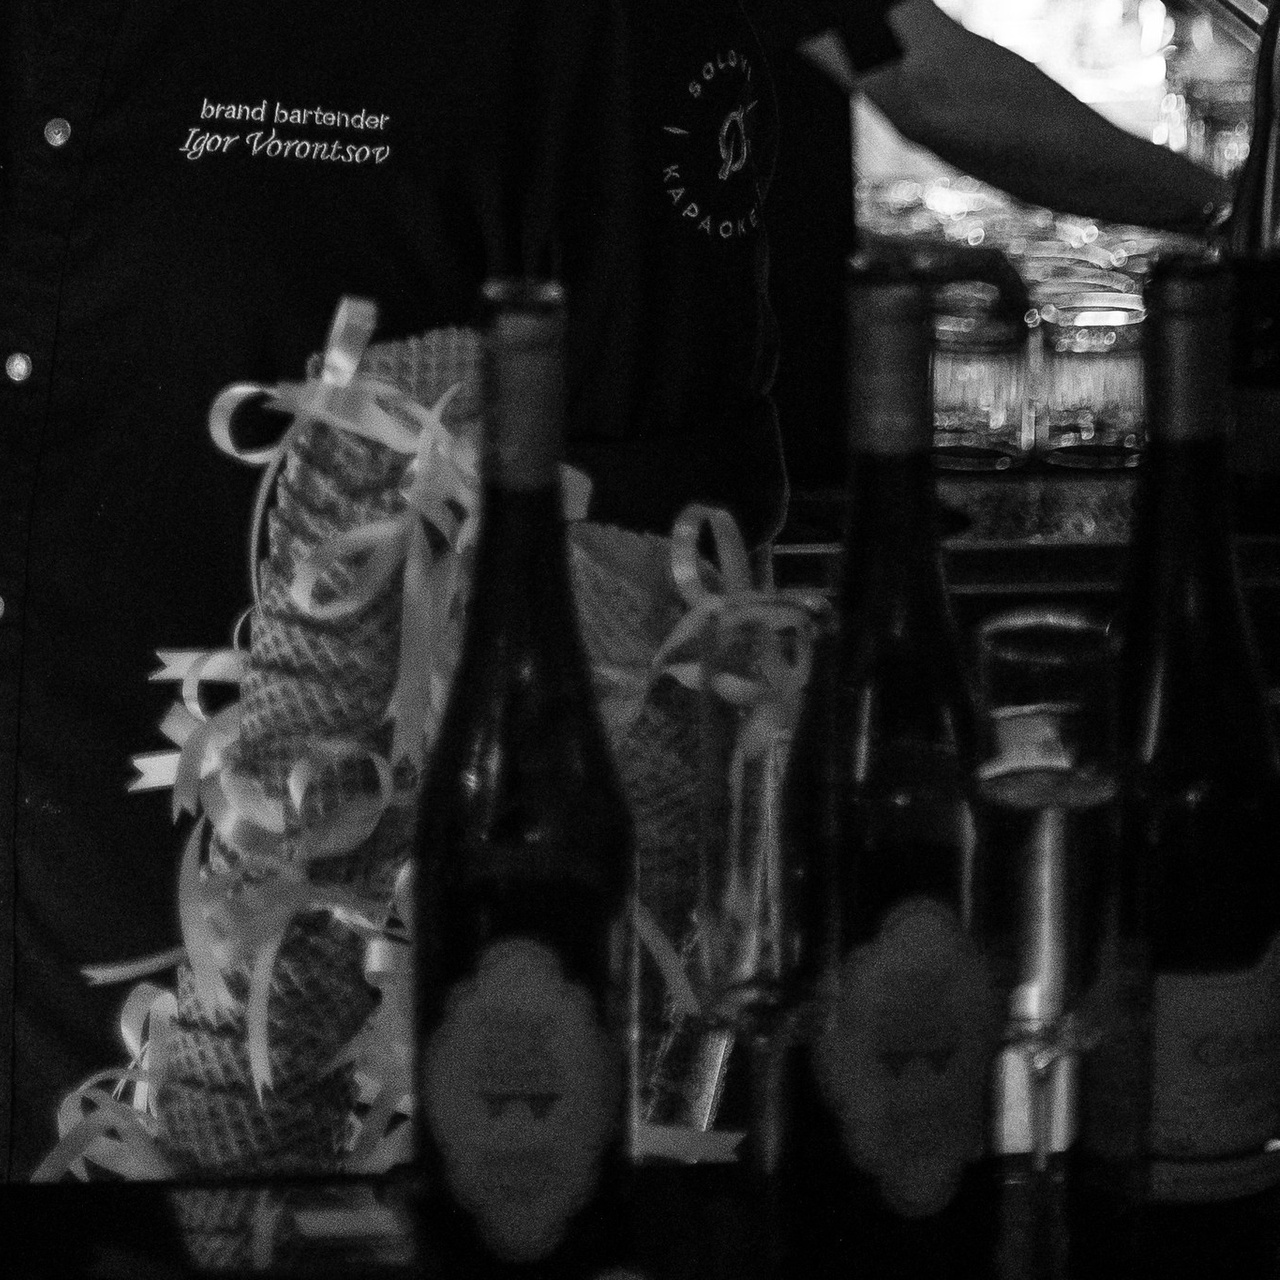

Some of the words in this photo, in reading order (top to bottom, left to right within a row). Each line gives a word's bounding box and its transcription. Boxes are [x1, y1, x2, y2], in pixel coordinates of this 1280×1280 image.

[200, 98, 267, 122] brand
[273, 101, 390, 130] bartender
[178, 127, 240, 161] Igor
[245, 127, 390, 164] Vorontsov
